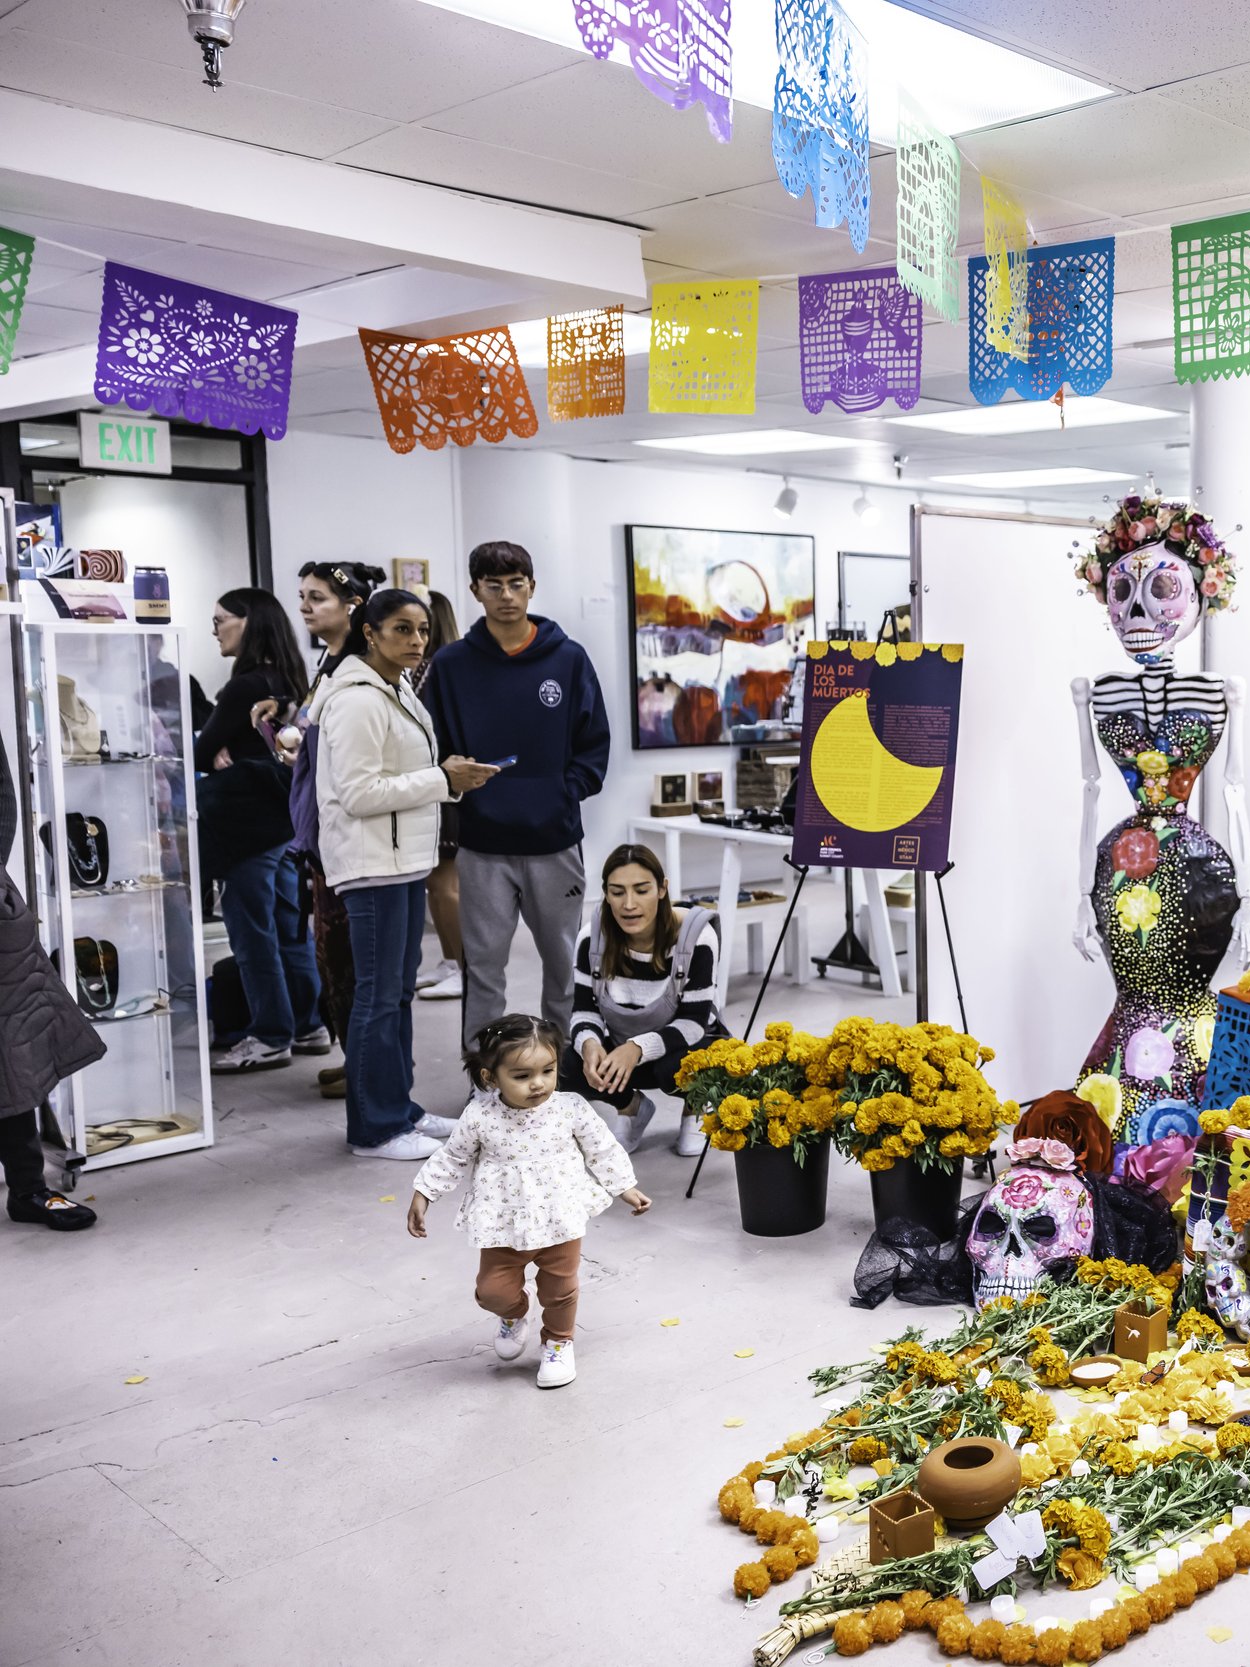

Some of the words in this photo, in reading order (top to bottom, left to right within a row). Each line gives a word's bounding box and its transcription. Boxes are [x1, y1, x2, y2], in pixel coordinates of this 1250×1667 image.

[99, 422, 157, 465] EXIT
[813, 664, 835, 676] DIA
[838, 664, 855, 676] DE
[813, 675, 836, 687] LOS
[812, 687, 871, 699] MUERTOS
